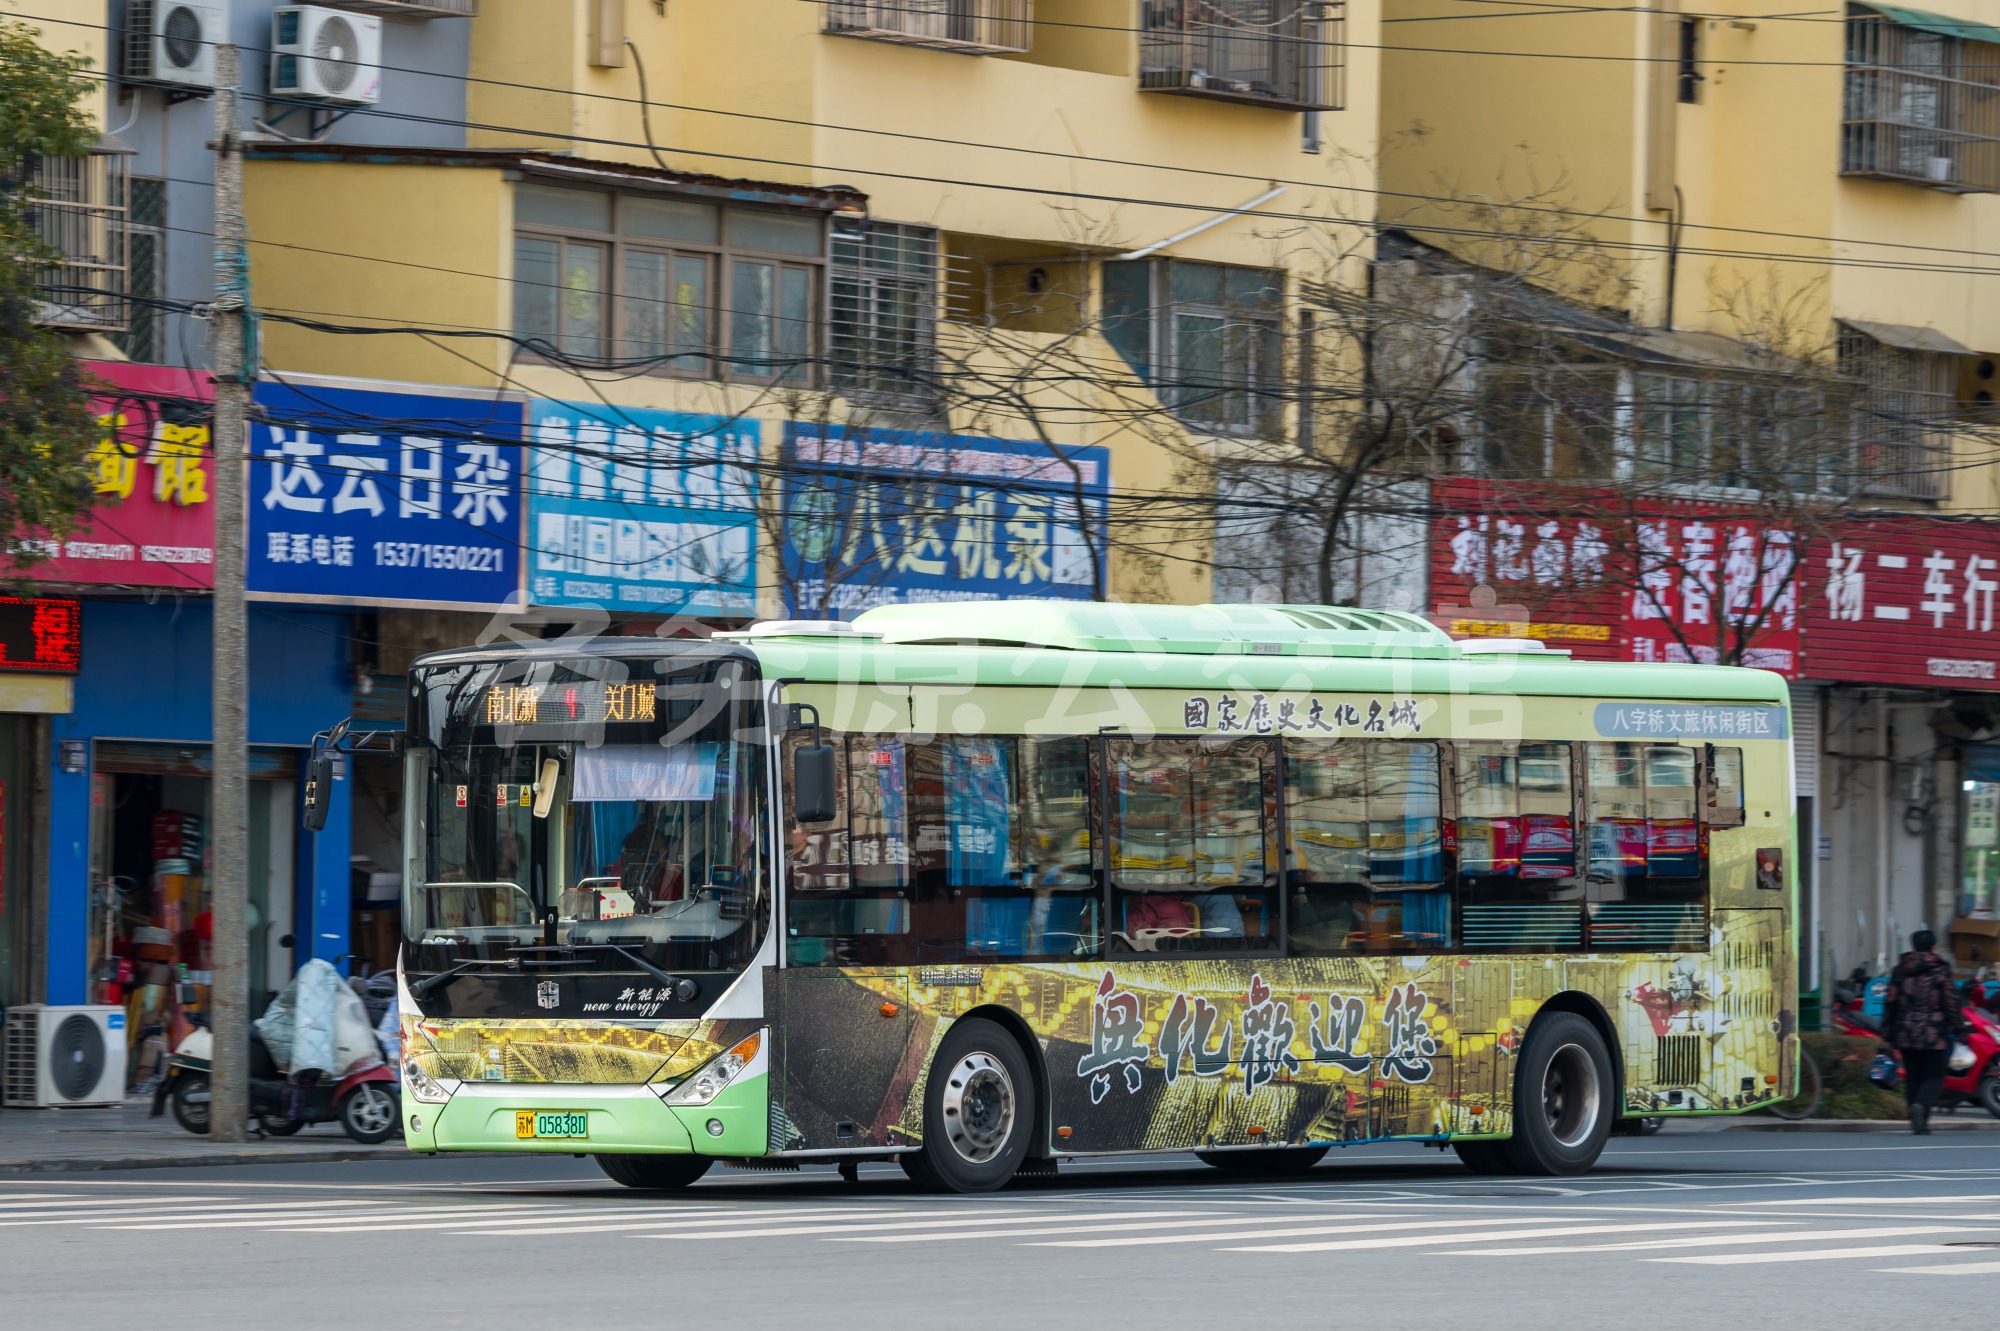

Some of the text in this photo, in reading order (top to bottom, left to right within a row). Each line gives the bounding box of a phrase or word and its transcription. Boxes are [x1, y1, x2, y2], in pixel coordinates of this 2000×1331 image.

[263, 421, 511, 527] 达云日杂
[266, 531, 504, 573] 联系电话 15371550221
[1825, 542, 1998, 632] 杨二车行
[566, 689, 576, 718] 4
[1184, 693, 1421, 734] 國家歷史文化名城
[1612, 707, 1770, 734] 八字桥文旅休闲街区
[583, 1002, 663, 1017] new energy
[617, 987, 672, 1002] 新能源
